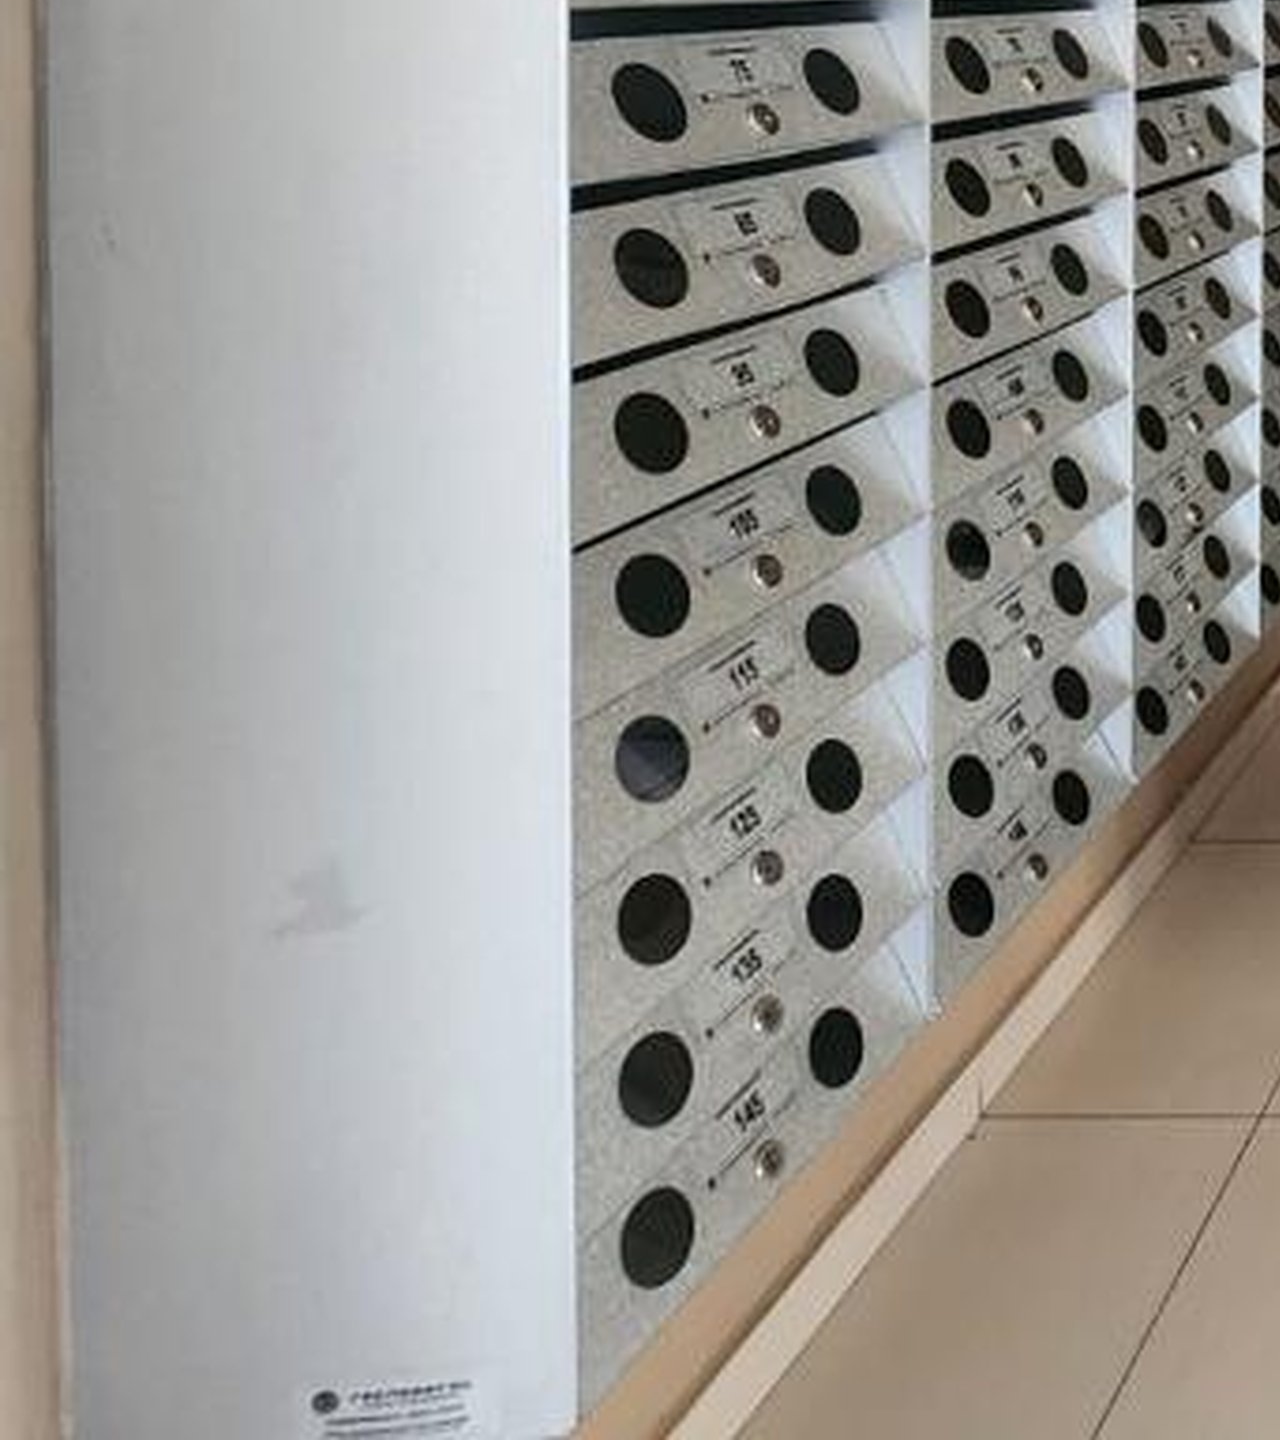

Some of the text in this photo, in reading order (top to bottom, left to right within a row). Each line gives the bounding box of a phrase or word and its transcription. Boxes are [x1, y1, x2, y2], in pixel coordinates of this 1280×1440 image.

[728, 508, 760, 540] 105
[728, 657, 760, 691] 115
[729, 804, 763, 839] 125
[732, 948, 762, 982] 135
[734, 1092, 764, 1131] 145
